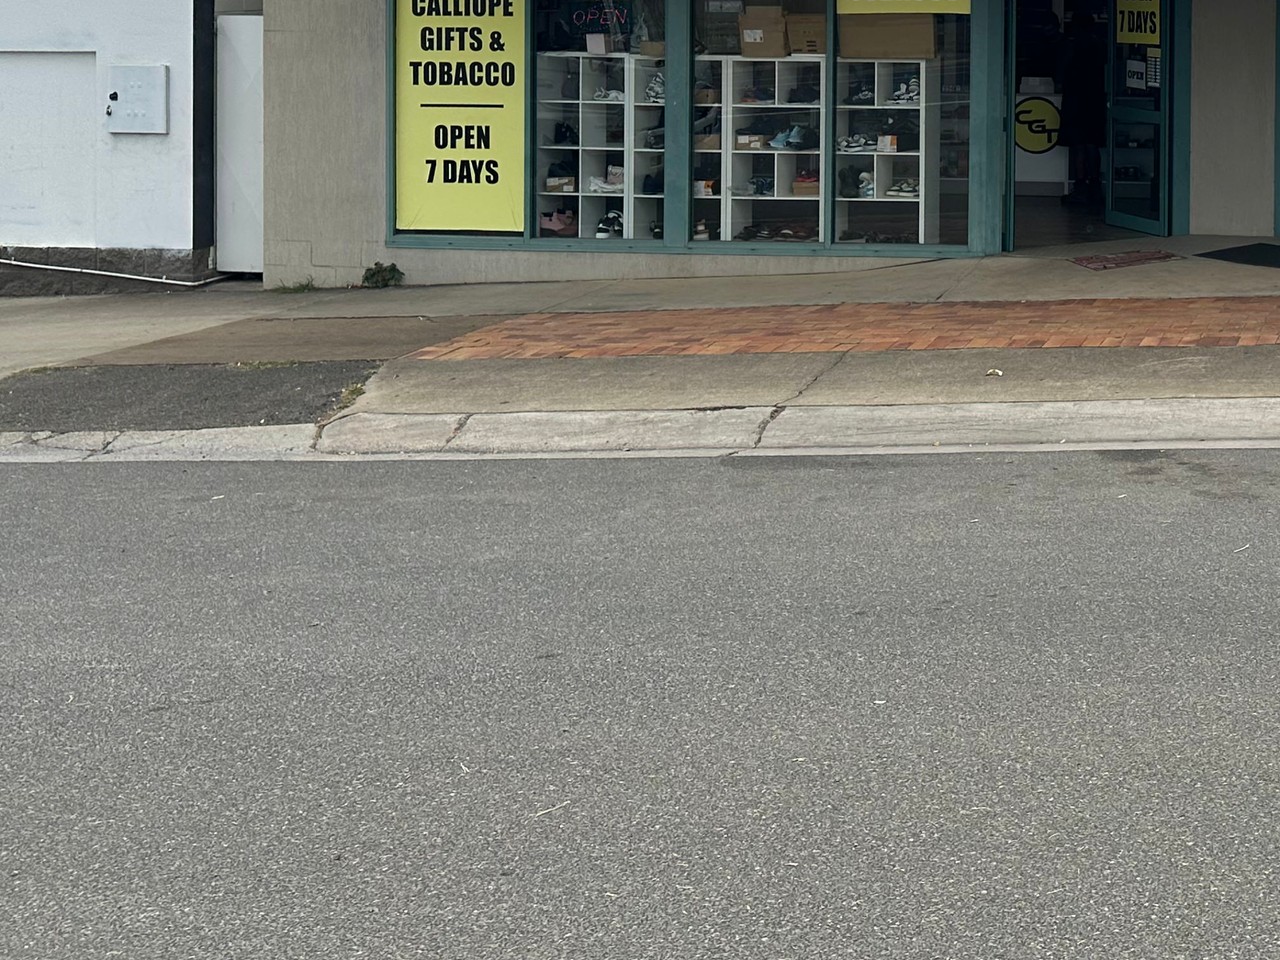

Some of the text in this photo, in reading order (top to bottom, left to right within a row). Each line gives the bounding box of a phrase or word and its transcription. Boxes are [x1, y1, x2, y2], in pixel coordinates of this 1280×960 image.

[573, 7, 628, 25] OPEN
[1118, 10, 1157, 35] 7 DAYS
[420, 26, 506, 52] GIFTS &
[408, 60, 516, 87] TOBACCO
[1127, 69, 1144, 81] OPEN
[434, 124, 491, 150] OPEN
[425, 159, 499, 185] 7 DAYS
